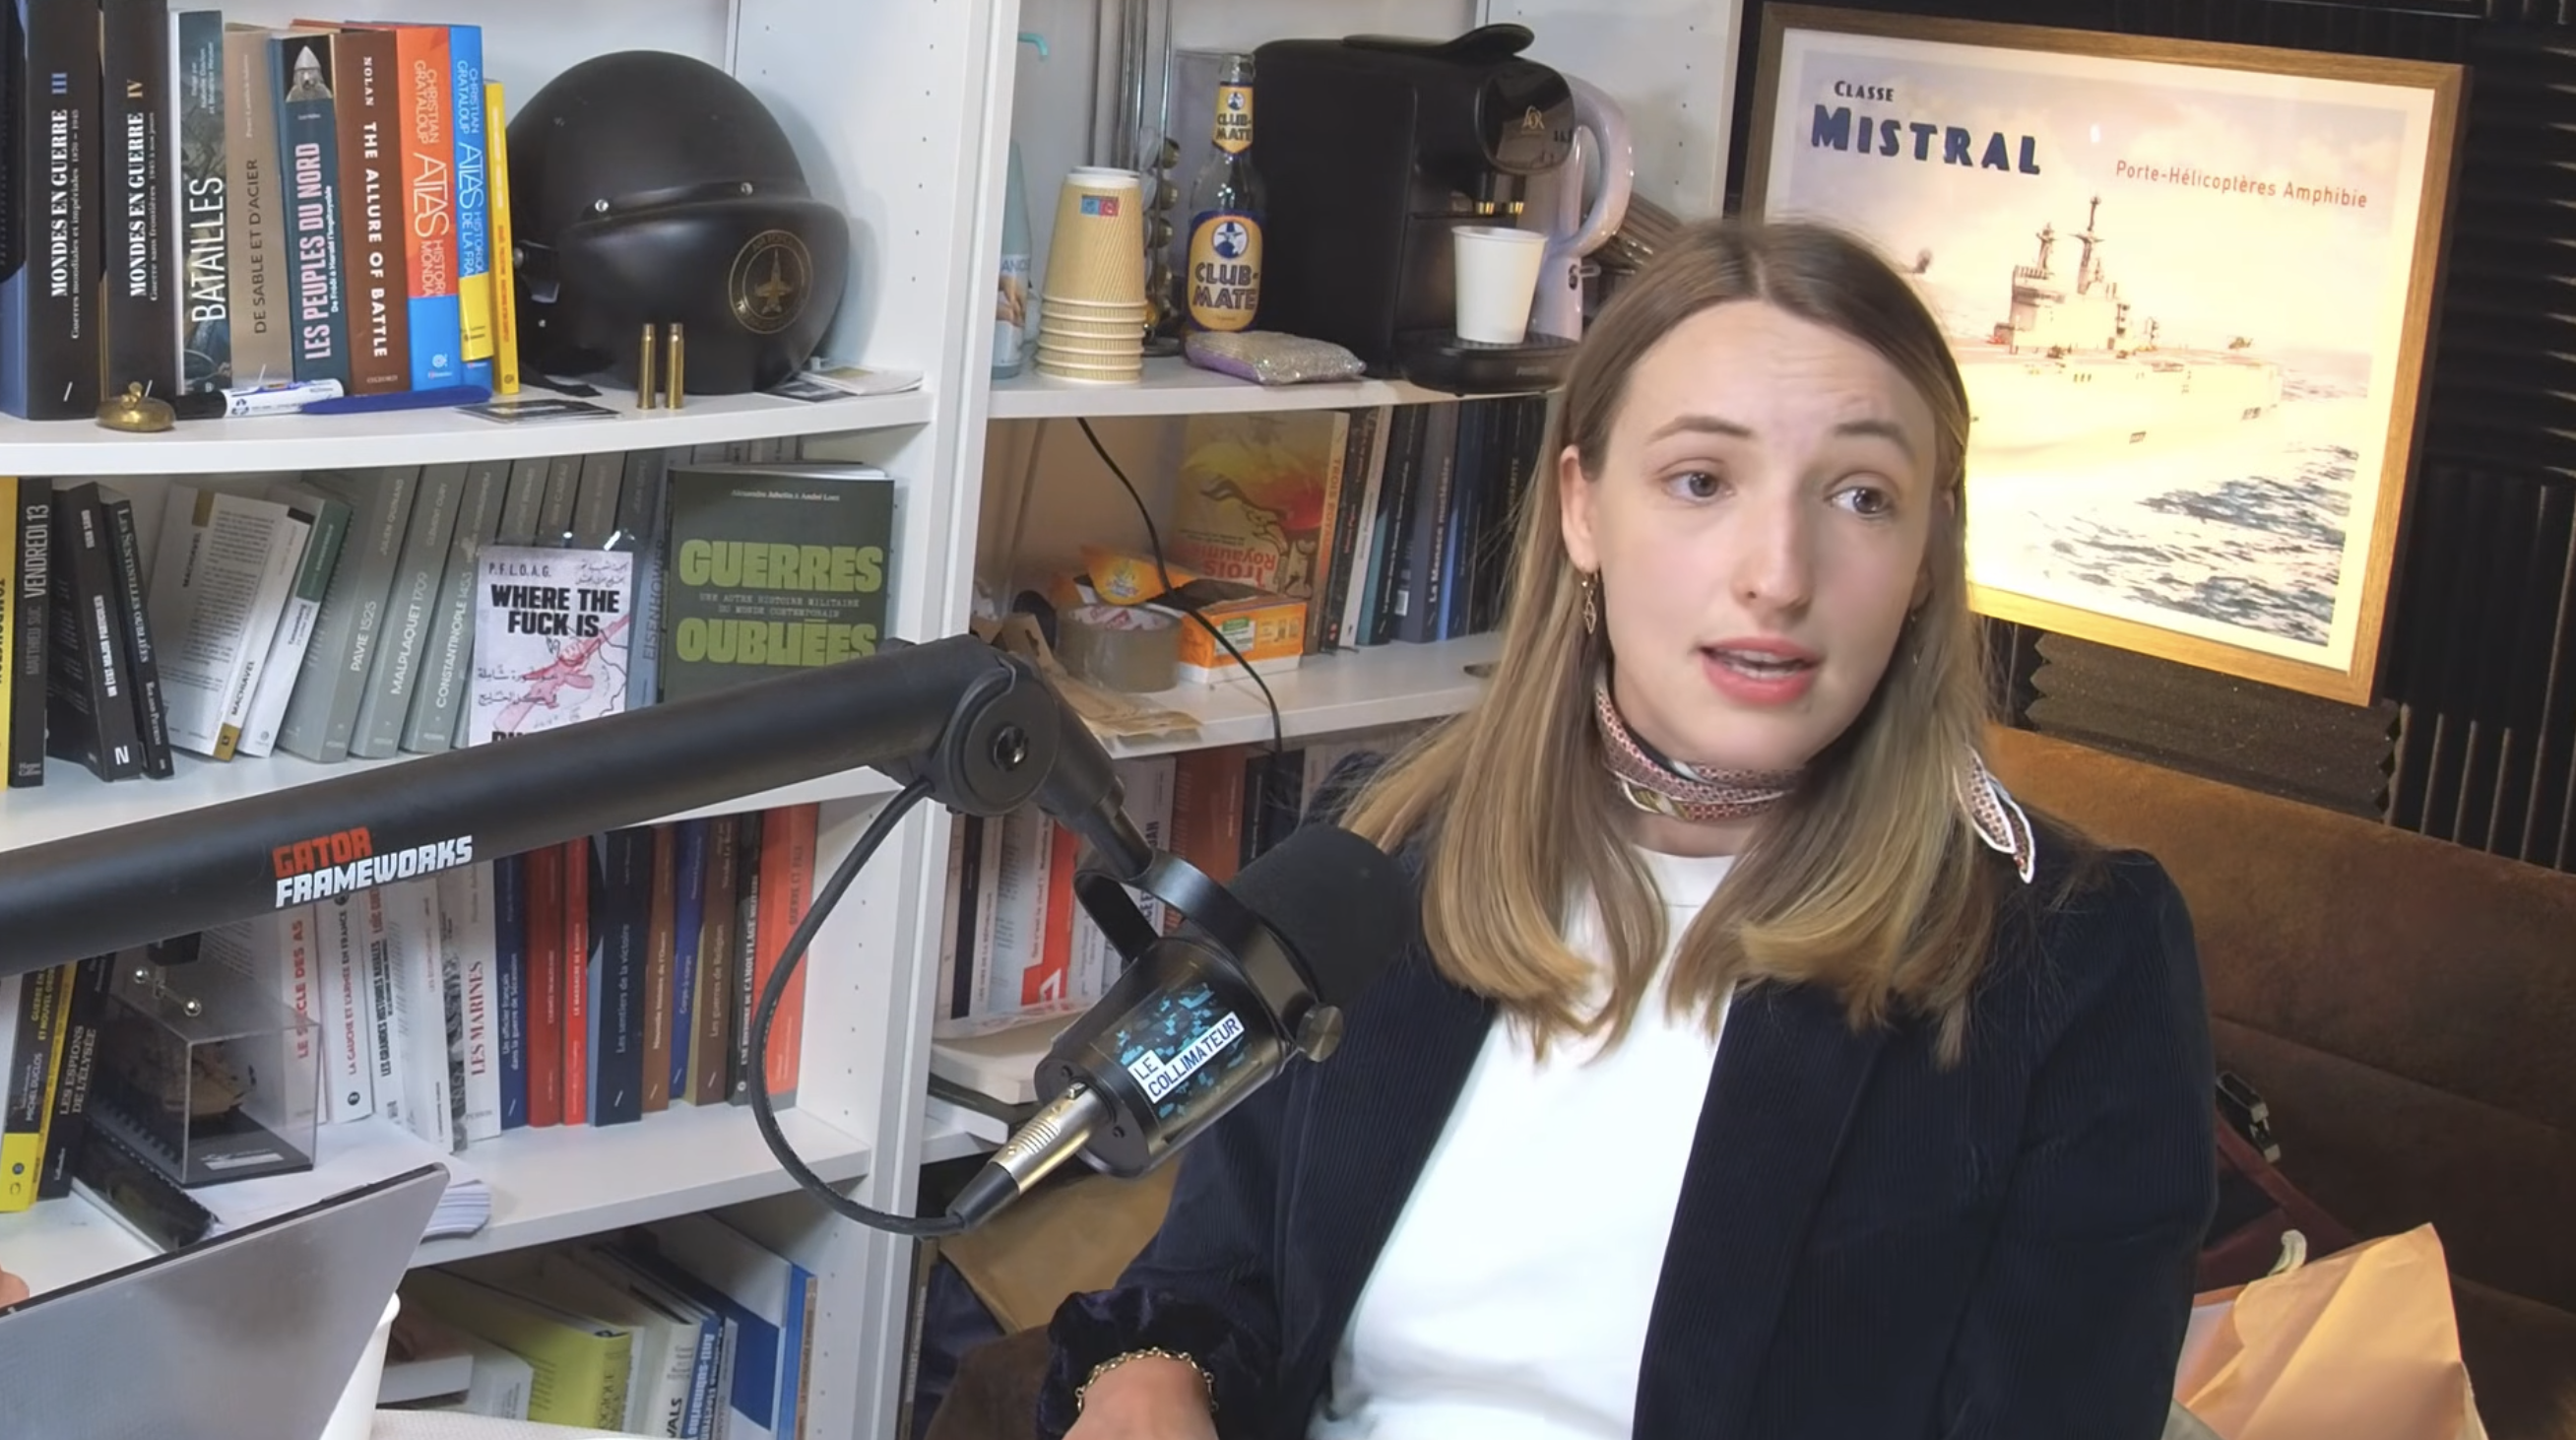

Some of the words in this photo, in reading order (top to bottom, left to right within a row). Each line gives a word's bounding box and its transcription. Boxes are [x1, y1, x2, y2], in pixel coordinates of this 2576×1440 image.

[51, 73, 67, 94] III
[127, 79, 143, 98] IV
[363, 56, 375, 106] NOLAN
[457, 60, 470, 134] GRATALOUP
[414, 60, 428, 145] GRATALOUP
[427, 68, 439, 143] CHRISTIAN
[468, 68, 480, 134] CHRISTIAN
[1216, 112, 1253, 127] CLUB-
[51, 109, 67, 186] GUERRE
[128, 112, 145, 188] GUERRE
[363, 122, 378, 159] THE
[1215, 126, 1253, 142] MATE
[295, 143, 321, 200] NORD
[458, 141, 483, 210] ATLAS
[2115, 159, 2277, 197] Porte-Hélicoptères
[2283, 180, 2368, 208] Amphibie
[51, 191, 67, 216] EN
[70, 168, 82, 224] impériales
[129, 192, 145, 217] EN
[149, 185, 158, 237] frontières
[246, 159, 263, 225] D'ACIER
[365, 168, 382, 242] ALLURE
[414, 152, 450, 237] ATLAS
[71, 226, 80, 236] et
[297, 202, 324, 231] DU
[461, 212, 473, 229] DE
[51, 220, 68, 296] MONDES
[189, 176, 226, 322] BATAILLES
[249, 228, 264, 250] ET
[463, 231, 474, 250] LA
[71, 239, 80, 294] mondiales
[129, 221, 147, 296] MONDES
[369, 251, 384, 279] OF
[1194, 261, 1259, 287] CLUB-
[149, 264, 159, 301] Guerre
[250, 255, 266, 307] SABLE
[298, 235, 329, 321] PEUPLES
[1192, 285, 1258, 311] MATE
[71, 296, 80, 339] Guerres
[254, 310, 267, 334] DE
[370, 288, 388, 357] BATTLE
[303, 332, 331, 360] LES
[1439, 457, 1450, 523] nucléaire
[26, 504, 49, 521] 13
[24, 523, 47, 599] VENDREDI
[488, 562, 551, 578] P.F.L.O.A.G.
[679, 539, 883, 593] GUERRES
[1431, 525, 1445, 583] Menace
[1203, 560, 1265, 589] Trois
[490, 584, 571, 612] WHERE
[577, 589, 619, 613] THE
[699, 593, 718, 602] UNE
[723, 593, 753, 603] AUTRE
[758, 595, 804, 606] HISTOIRE
[808, 597, 860, 608] MILITAIRE
[736, 606, 765, 616] MONDE
[770, 607, 840, 618] CONTEMPORAIN
[1429, 585, 1438, 603] La
[351, 633, 369, 672] PAVIE
[360, 601, 377, 632] 1525
[391, 604, 421, 695] MALPLAQUET
[414, 572, 428, 603] 1709
[436, 600, 467, 708] CONSTANTINOPLE
[459, 571, 473, 600] 1453
[507, 611, 569, 636] FUCK
[576, 615, 600, 638] IS
[676, 618, 877, 667] OUBLIÉES
[231, 661, 255, 716] MACHIAVEL
[272, 826, 373, 879] GATOR
[275, 835, 473, 908] FRAMEWORKS
[291, 920, 303, 942] AS
[339, 910, 350, 949] FRANCE
[620, 924, 630, 962] victoire
[714, 924, 725, 964] Religion
[293, 947, 306, 978] DES
[341, 949, 351, 964] EN
[510, 952, 519, 996] Sécession
[619, 964, 628, 975] la
[714, 965, 723, 979] de
[743, 919, 756, 992] CAMOUFLAGE
[342, 965, 354, 1005] L'ARMÉE
[468, 960, 484, 1041] MARINES
[501, 973, 512, 1008] français
[619, 975, 628, 990] de
[711, 980, 722, 1018] guerres
[39, 993, 52, 1028] NOUVEL
[345, 1006, 354, 1018] ET
[511, 997, 518, 1009] de
[617, 991, 627, 1032] sentiers
[346, 1020, 356, 1061] GAUCHE
[377, 1021, 390, 1060] GRANDES
[502, 1009, 511, 1039] officier
[511, 1010, 520, 1038] guerre
[709, 1018, 719, 1037] Les
[74, 1028, 97, 1091] L'ÉLYSÉE
[297, 1044, 309, 1059] LE
[470, 1042, 485, 1076] LES
[502, 1040, 511, 1054] Un
[615, 1034, 626, 1054] Les
[1147, 1017, 1240, 1097] COLLIMATEUR
[59, 1088, 70, 1114] LES
[65, 1025, 85, 1085] ESPIONS
[348, 1062, 357, 1075] LA
[380, 1061, 392, 1077] LES
[1133, 1056, 1159, 1080] LE
[26, 1088, 37, 1121] MICHEL
[72, 1093, 83, 1113] DE
[687, 1333, 716, 1435] Anti-submarine
